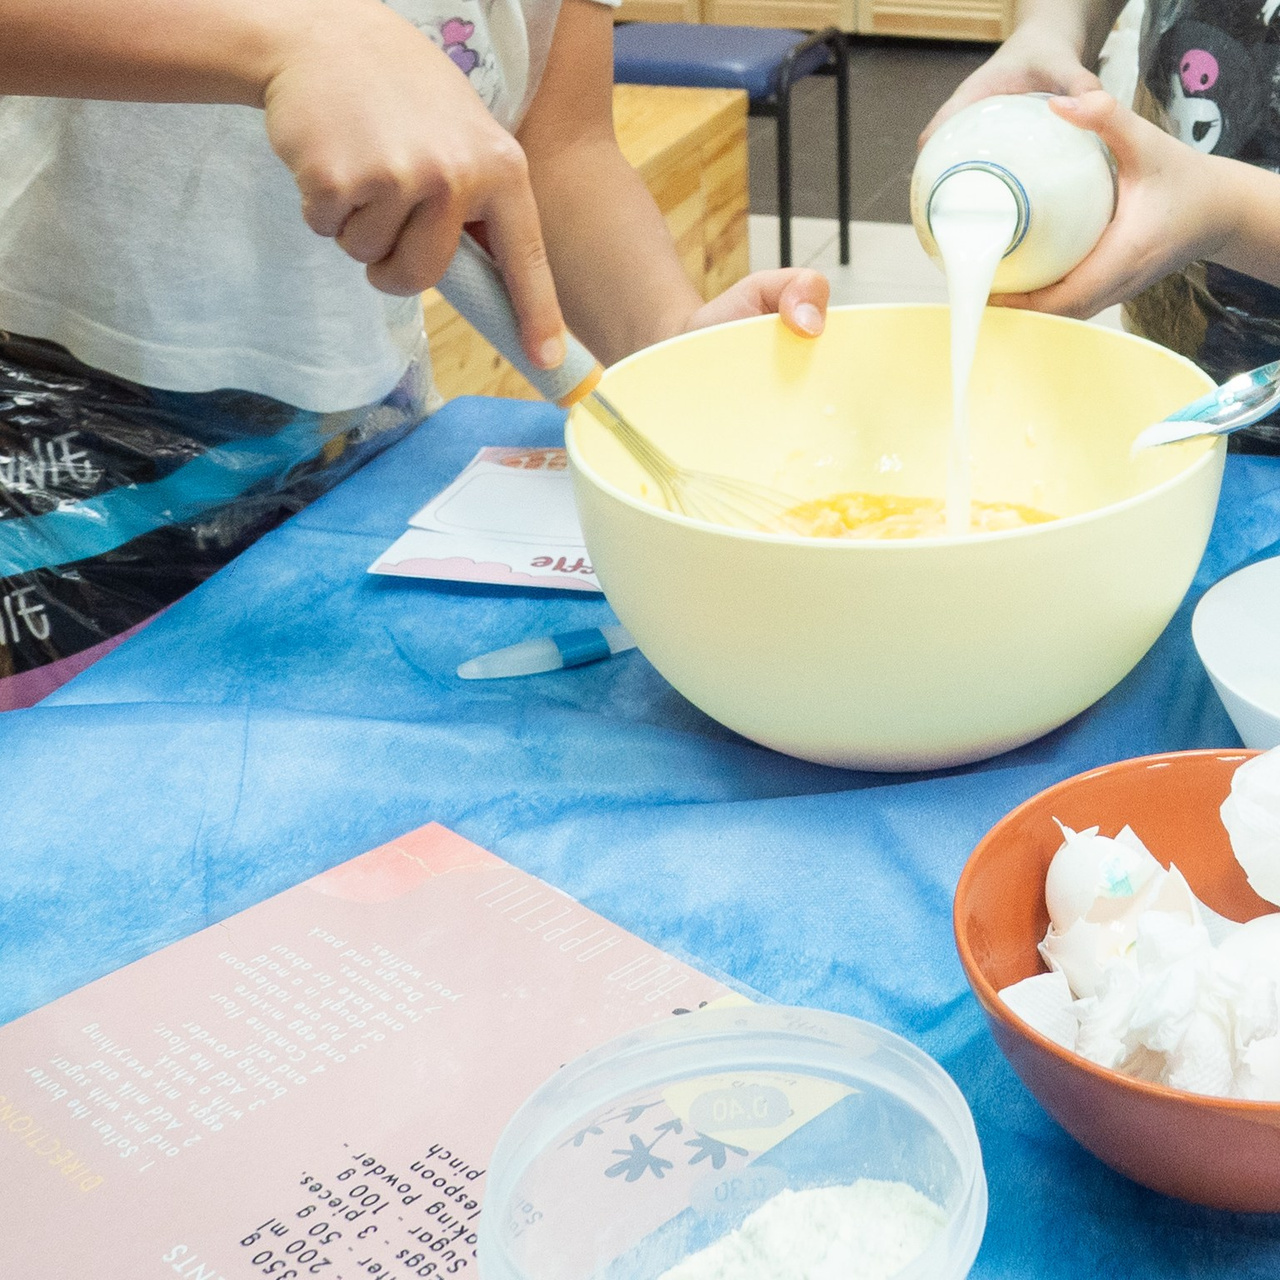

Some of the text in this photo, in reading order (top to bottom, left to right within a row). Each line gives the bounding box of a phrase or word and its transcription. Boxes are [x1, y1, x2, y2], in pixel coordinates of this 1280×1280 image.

[307, 926, 349, 949] pack
[339, 948, 373, 967] and
[217, 951, 294, 1003] tablespoon
[269, 944, 405, 1031] and bake for about
[374, 967, 425, 1003] Design
[607, 954, 691, 1003] BON
[304, 986, 321, 999] in
[424, 979, 465, 1003] your
[208, 992, 246, 1020] flour
[293, 1001, 322, 1021] one
[318, 997, 367, 1030] dough
[395, 1003, 424, 1024] two
[245, 1016, 307, 1062] Combine
[287, 1019, 317, 1041] egg
[319, 1022, 348, 1042] Put
[360, 1029, 386, 1042] of
[80, 1022, 156, 1079] everything
[181, 1021, 288, 1100] baking powder
[189, 1052, 215, 1072] the
[311, 1042, 347, 1063] and
[84, 1059, 120, 1081] and
[208, 1070, 248, 1095] Add
[271, 1063, 308, 1085] and
[24, 1066, 69, 1103] butter
[115, 1080, 152, 1105] milk
[153, 1078, 182, 1100] mix
[66, 1098, 93, 1120] the
[86, 1086, 122, 1113] with
[208, 1095, 244, 1121] with
[121, 1110, 151, 1133] mix
[143, 1105, 184, 1130] Add
[90, 1117, 140, 1158] Soften
[142, 1133, 180, 1157] and
[336, 1168, 357, 1181] g
[425, 1143, 486, 1181] pinch
[351, 1153, 423, 1206] Powder
[299, 1171, 367, 1222] pieces.
[348, 1184, 390, 1215] 100
[296, 1205, 317, 1219] g
[240, 1232, 262, 1247] g
[256, 1218, 290, 1237] ml
[308, 1222, 343, 1245] 50
[356, 1225, 378, 1239] 3
[424, 1201, 477, 1258] aking
[285, 1239, 332, 1274] 200
[407, 1226, 468, 1274] Sugar
[396, 1250, 444, 1280] ggs
